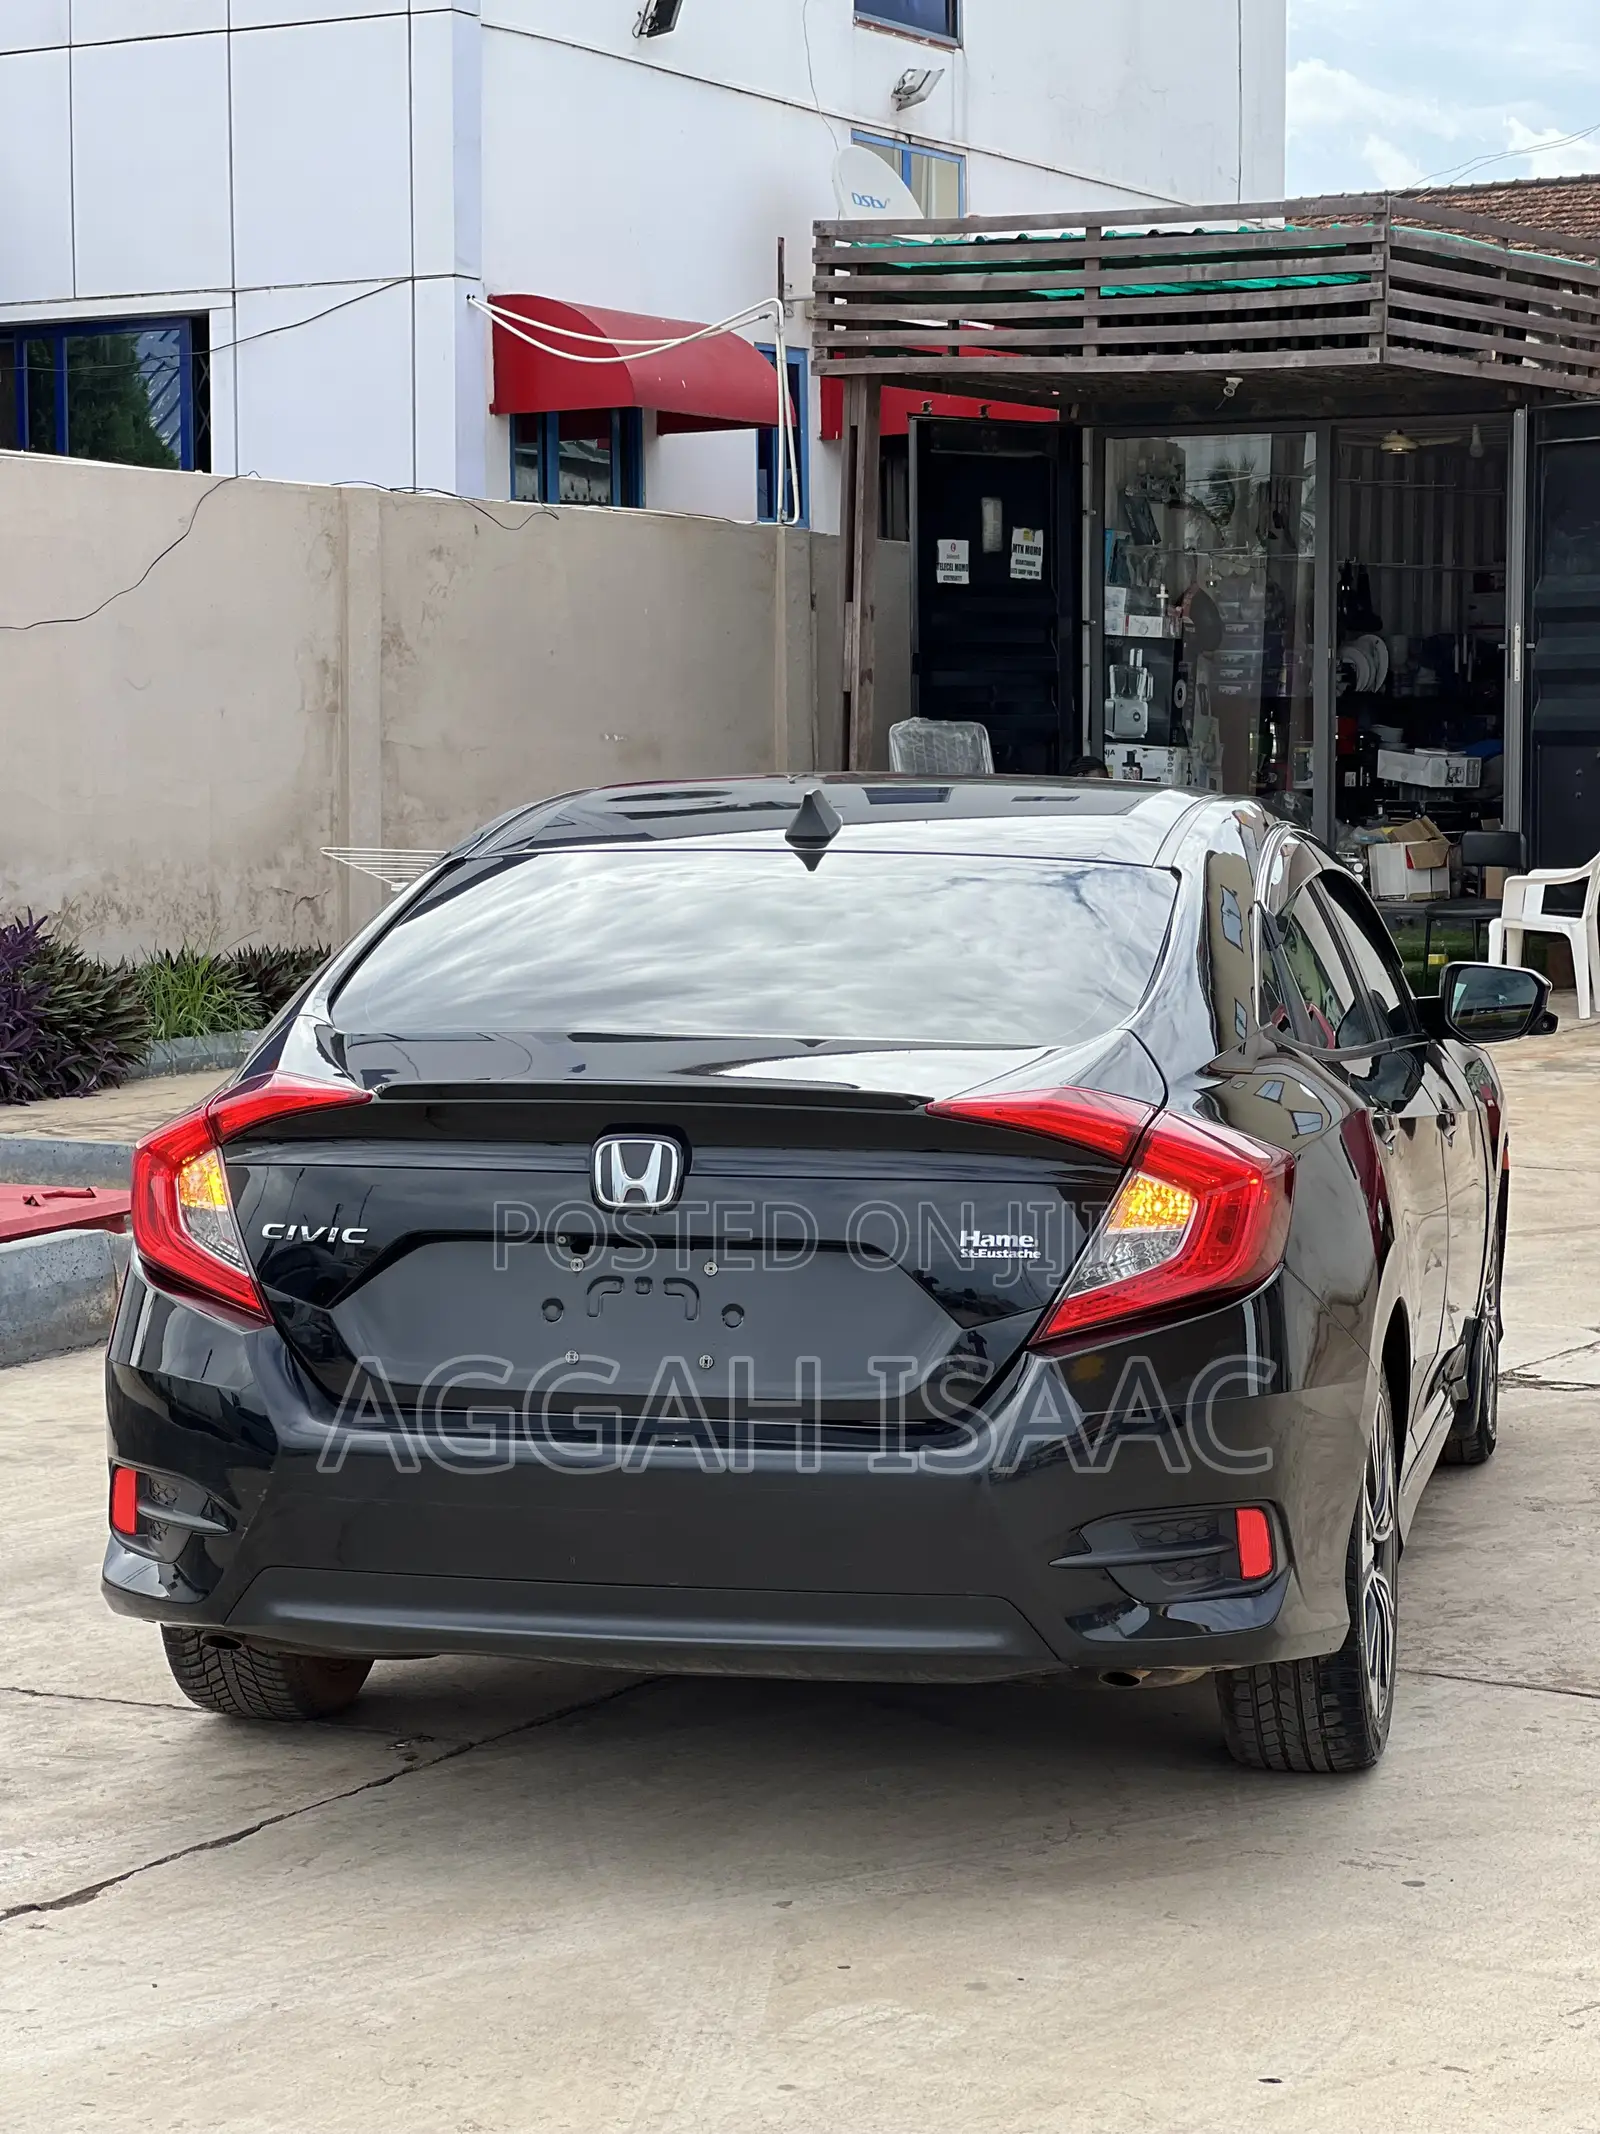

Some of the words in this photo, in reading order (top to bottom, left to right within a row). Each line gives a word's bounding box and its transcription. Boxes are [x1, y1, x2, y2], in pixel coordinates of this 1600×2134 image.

[851, 192, 888, 209] DStv
[261, 1223, 369, 1245] CIVIC
[960, 1248, 1042, 1259] St-Eustache
